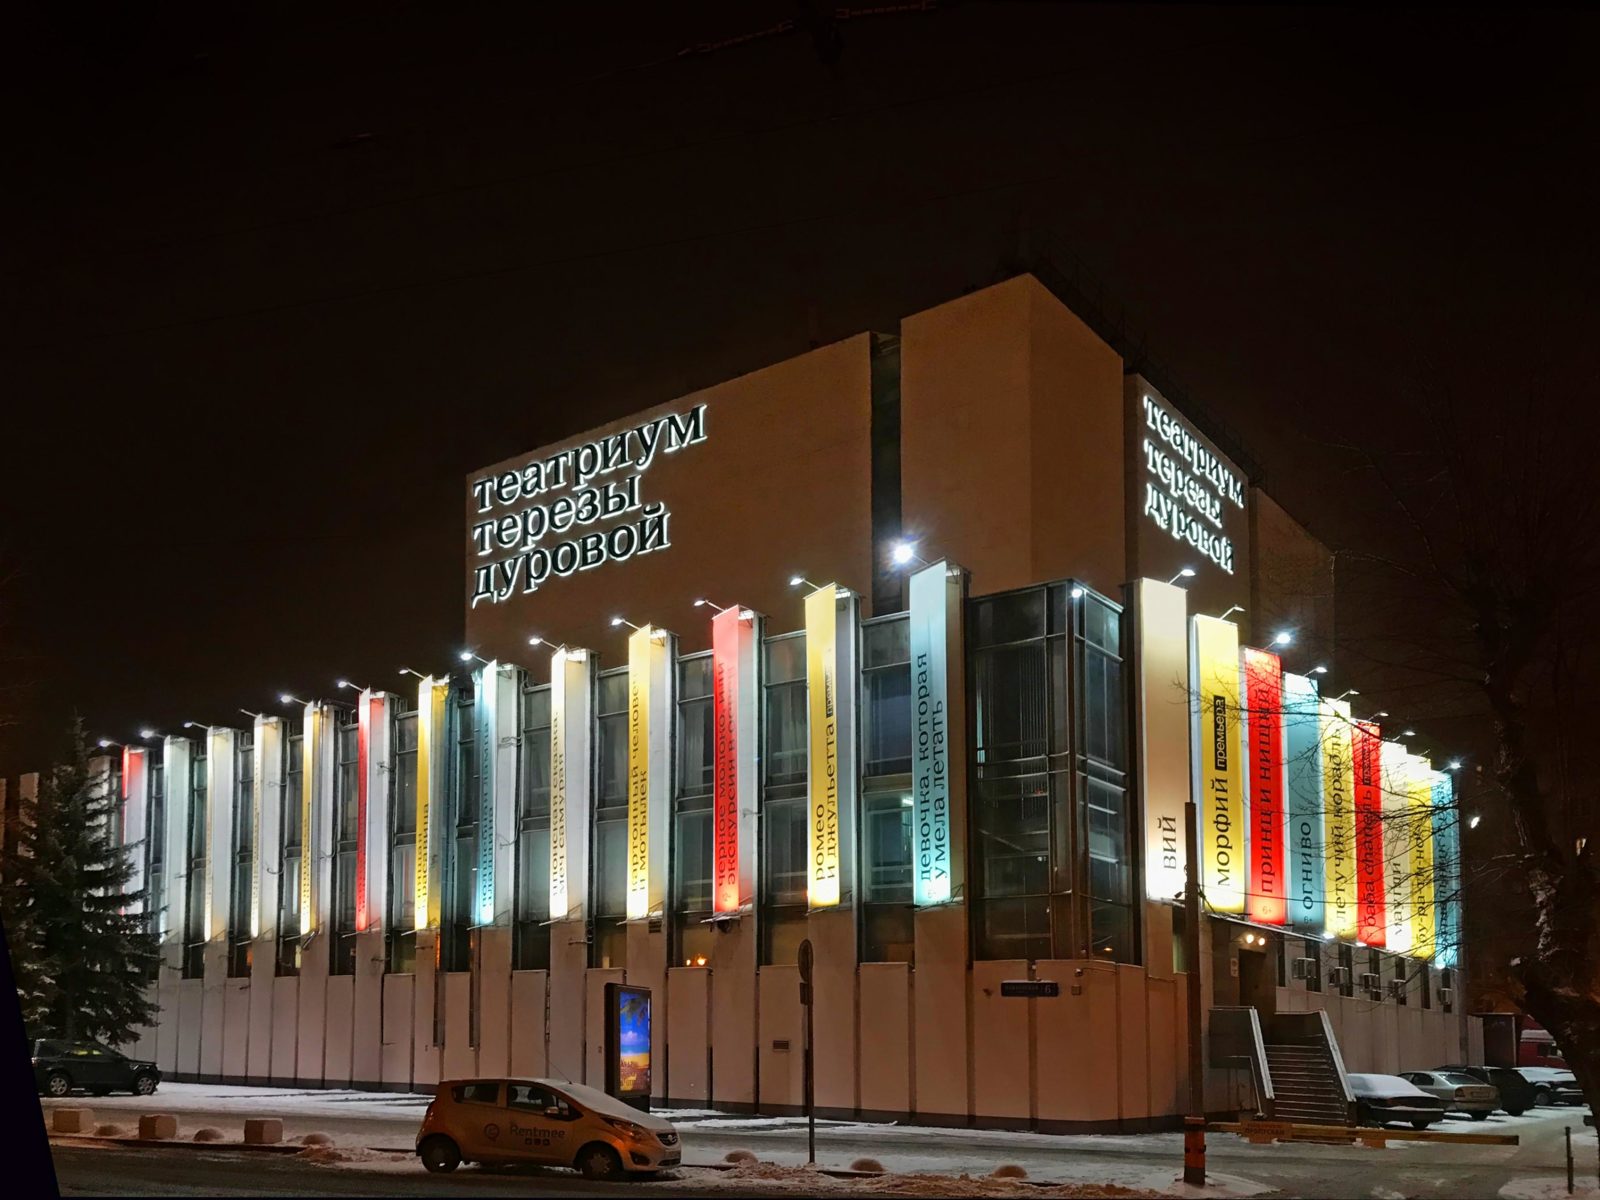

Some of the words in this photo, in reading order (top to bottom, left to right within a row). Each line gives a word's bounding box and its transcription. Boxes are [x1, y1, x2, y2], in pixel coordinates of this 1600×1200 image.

[473, 404, 708, 513] театриум
[1143, 395, 1244, 509] театриум
[1143, 438, 1223, 529] терезы
[471, 501, 672, 609] дуровой
[473, 474, 643, 556] терезы
[1145, 482, 1235, 575] дуровой
[918, 653, 930, 761] которая
[932, 700, 945, 791] летать
[1216, 698, 1227, 768] премьера
[1257, 689, 1272, 781] нищий
[825, 723, 838, 858] джульетта
[1260, 789, 1271, 803] и
[1329, 729, 1344, 819] корабль
[639, 770, 647, 870] мотылек
[718, 805, 728, 887] черное
[727, 759, 738, 886] экскурсия
[816, 804, 826, 881] ромео
[919, 767, 932, 882] девочка,
[933, 797, 948, 878] умела
[1157, 816, 1176, 870] вий
[1210, 775, 1233, 887] морфий
[1260, 810, 1275, 893] принц
[828, 864, 836, 878] и
[1300, 822, 1313, 910] огниво
[1331, 826, 1347, 922] летучий
[1362, 881, 1377, 927] баба
[510, 1123, 566, 1138] Rentmee
